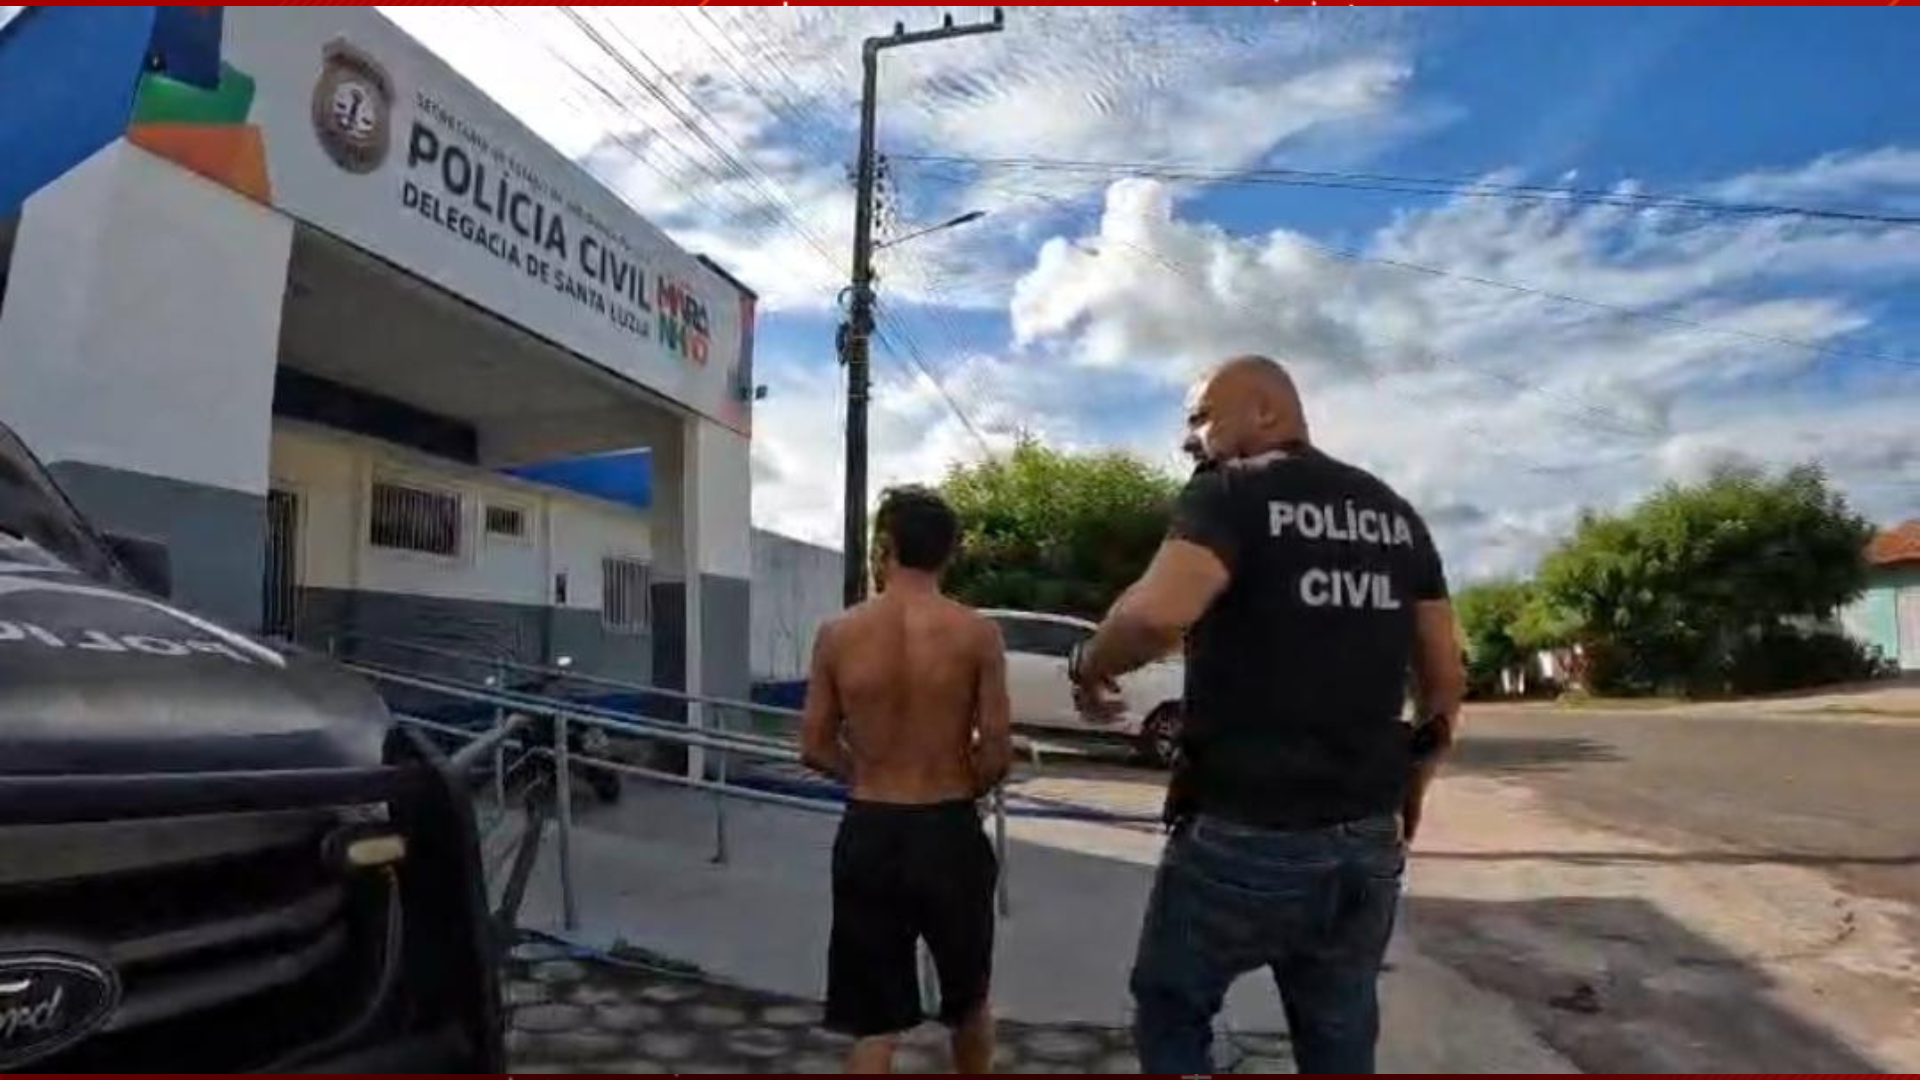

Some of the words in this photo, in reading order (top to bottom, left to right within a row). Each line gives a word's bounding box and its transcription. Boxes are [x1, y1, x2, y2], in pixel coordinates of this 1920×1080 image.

[403, 181, 520, 268] DELEGACIA
[527, 253, 549, 285] DE
[554, 269, 605, 314] SANTA
[610, 300, 649, 337] LUZIA
[408, 120, 565, 259] POLÍCIA
[579, 235, 652, 312] CIVIL
[1268, 499, 1413, 547] POLÍCIA
[1300, 568, 1401, 609] CIVIL
